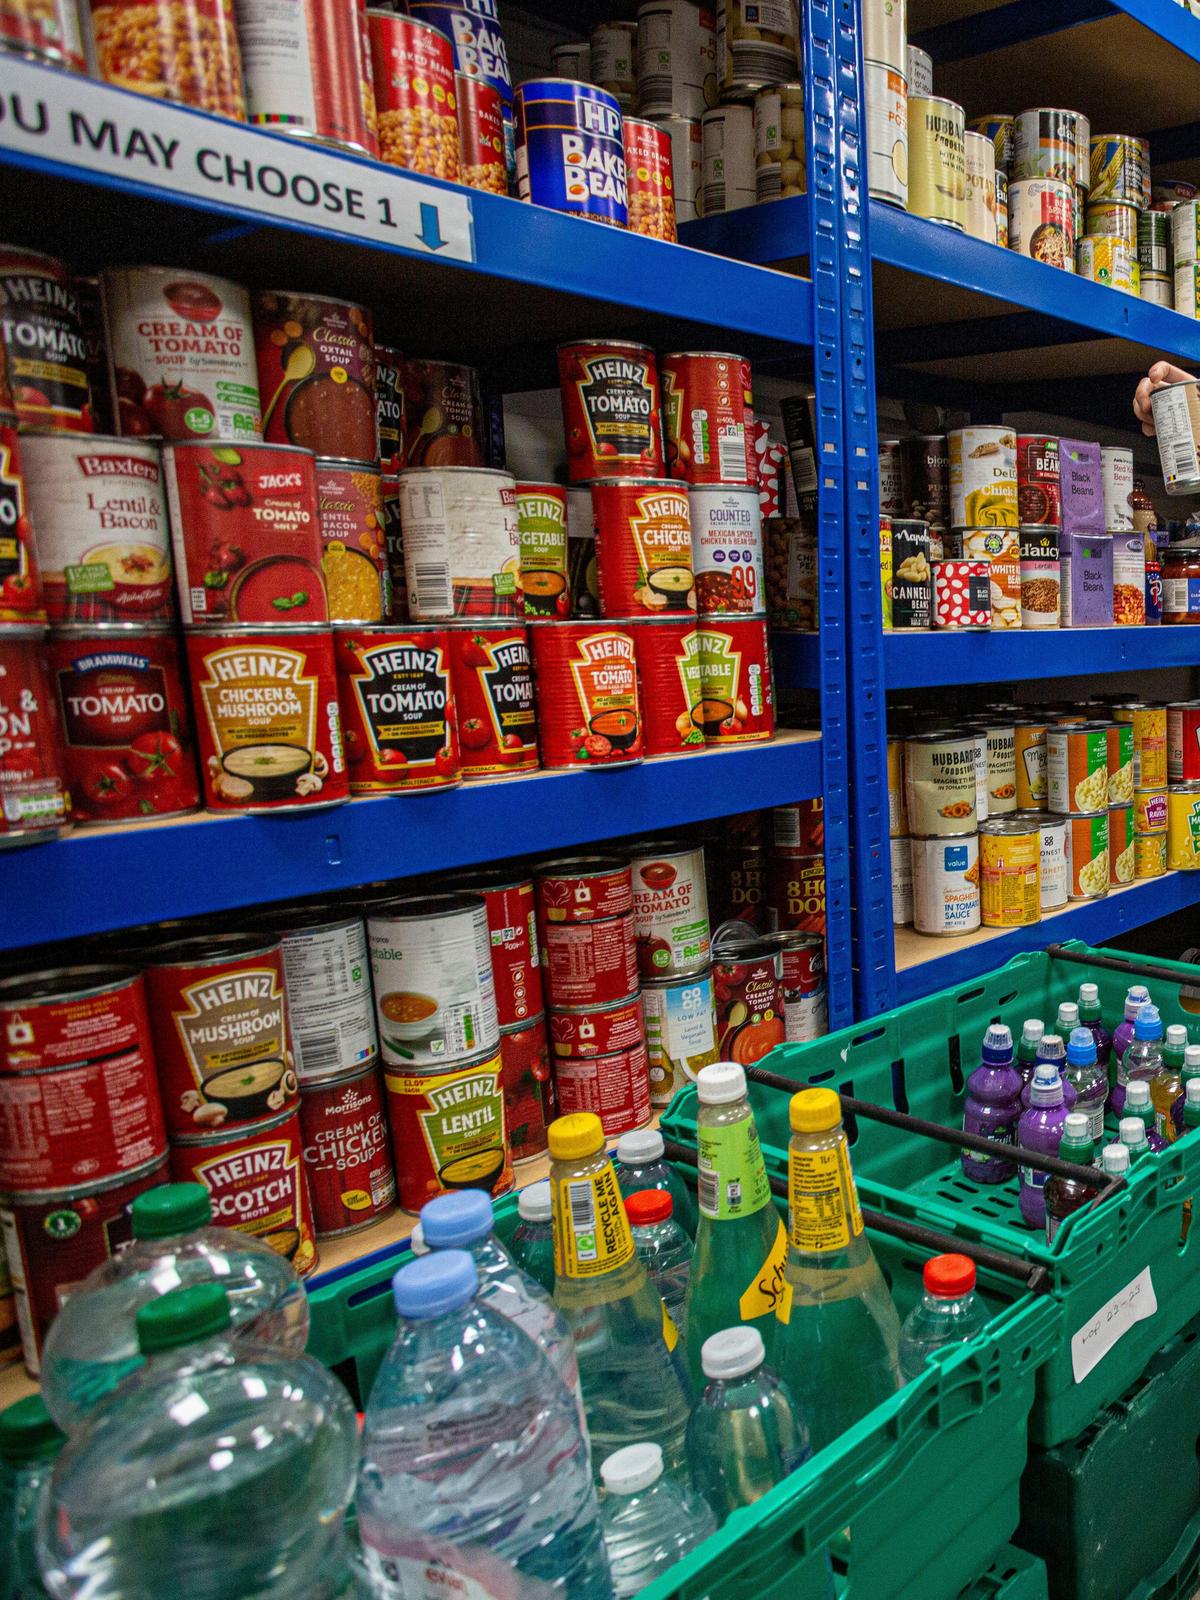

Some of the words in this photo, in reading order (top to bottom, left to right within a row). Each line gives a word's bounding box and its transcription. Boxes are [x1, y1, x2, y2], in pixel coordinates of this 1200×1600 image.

[584, 101, 620, 137] HP
[0, 93, 48, 135] U
[69, 110, 179, 170] MAY
[196, 149, 366, 219] CHOOSE
[377, 198, 398, 228] 1
[138, 321, 219, 341] CREAM
[223, 326, 243, 342] OF
[148, 338, 241, 356] TOMATO
[320, 345, 353, 357] OXTAIL
[155, 355, 186, 365] SOUP
[325, 354, 350, 364] SOUP
[592, 362, 643, 384] HEINZ
[588, 396, 649, 416] TOMATO
[83, 456, 159, 480] Baxters
[259, 473, 302, 489] JACK'S
[1072, 472, 1090, 482] Black
[1071, 484, 1094, 495] Beans
[87, 493, 147, 515] Lentil
[149, 501, 161, 516] &
[648, 499, 690, 519] HEINZ
[100, 512, 158, 530] Bacon
[253, 508, 310, 524] TOMATO
[709, 509, 751, 522] COUNTED
[273, 523, 299, 531] SOUP
[322, 529, 350, 538] SOUP
[1020, 544, 1059, 559] d'aucy
[731, 565, 757, 599] 99
[1084, 571, 1102, 580] Black
[1083, 582, 1104, 592] Beans
[590, 641, 630, 659] HEINZ
[77, 655, 147, 670] BRAMWELLS
[217, 656, 293, 681] HEINZ
[372, 651, 436, 676] HEINZ
[591, 670, 633, 684] TOMATO
[220, 688, 283, 703] CHICKEN
[285, 687, 297, 700] &
[367, 690, 445, 714] TOMATO
[67, 693, 165, 716] TOMATO
[217, 701, 302, 717] MUSHROOM
[111, 714, 132, 723] SOUP
[249, 717, 271, 725] SOUP
[403, 712, 423, 720] SOUP
[947, 858, 966, 868] value
[677, 883, 694, 896] OF
[944, 910, 971, 920] SAUCE
[199, 979, 271, 1010] HEINZ
[749, 996, 774, 1005] TOMATO
[754, 1002, 771, 1011] SOUP
[190, 1009, 281, 1044] MUSHROOM
[220, 1012, 249, 1024] CREAM
[677, 1014, 693, 1022] LOW
[233, 1035, 256, 1047] SOUP
[438, 1079, 496, 1108] HEINZ
[325, 1094, 372, 1116] Morrisons
[315, 1120, 365, 1144] CREAM
[367, 1112, 381, 1127] OF
[441, 1105, 496, 1135] LENTIL
[303, 1125, 387, 1163] CHICKEN
[336, 1147, 376, 1171] SOUP
[211, 1149, 285, 1189] HEINZ
[211, 1175, 293, 1217] SCOTCH
[595, 1178, 606, 1197] ME
[604, 1171, 620, 1216] AGAIN
[240, 1205, 270, 1221] BROTH
[599, 1199, 617, 1254] RECYCLE
